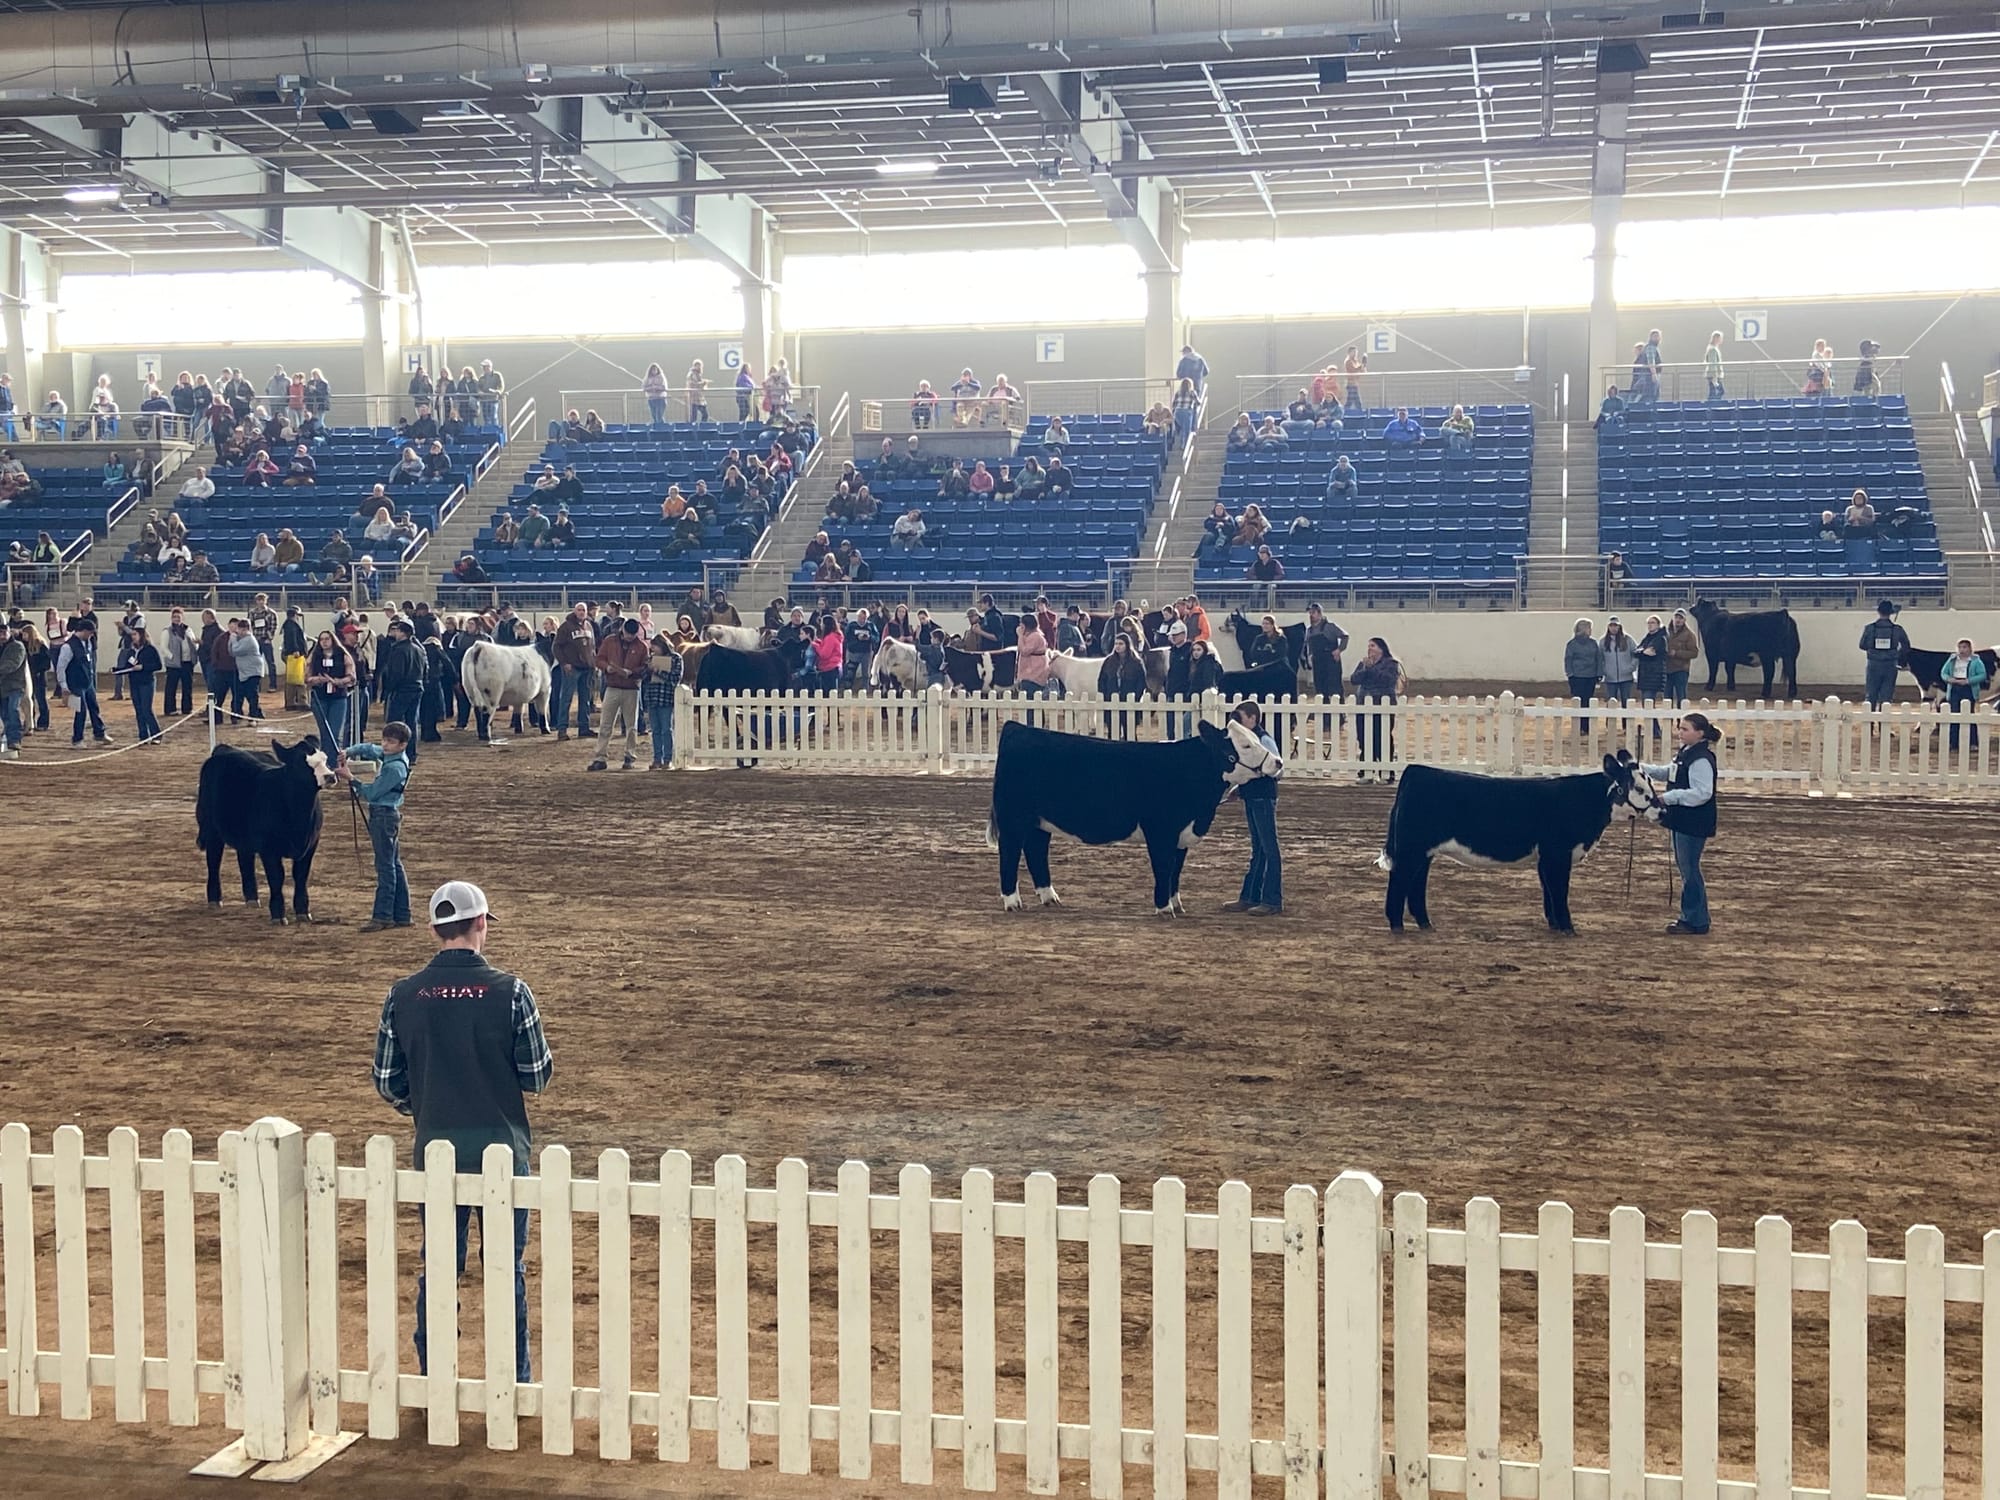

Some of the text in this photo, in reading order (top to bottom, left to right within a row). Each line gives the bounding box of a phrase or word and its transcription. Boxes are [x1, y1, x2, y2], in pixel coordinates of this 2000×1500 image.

[1743, 319, 1760, 339] D
[1374, 332, 1389, 351] E
[724, 350, 740, 368] G
[1044, 342, 1056, 360] F
[408, 354, 421, 371] H
[416, 984, 488, 999] ARIAT
